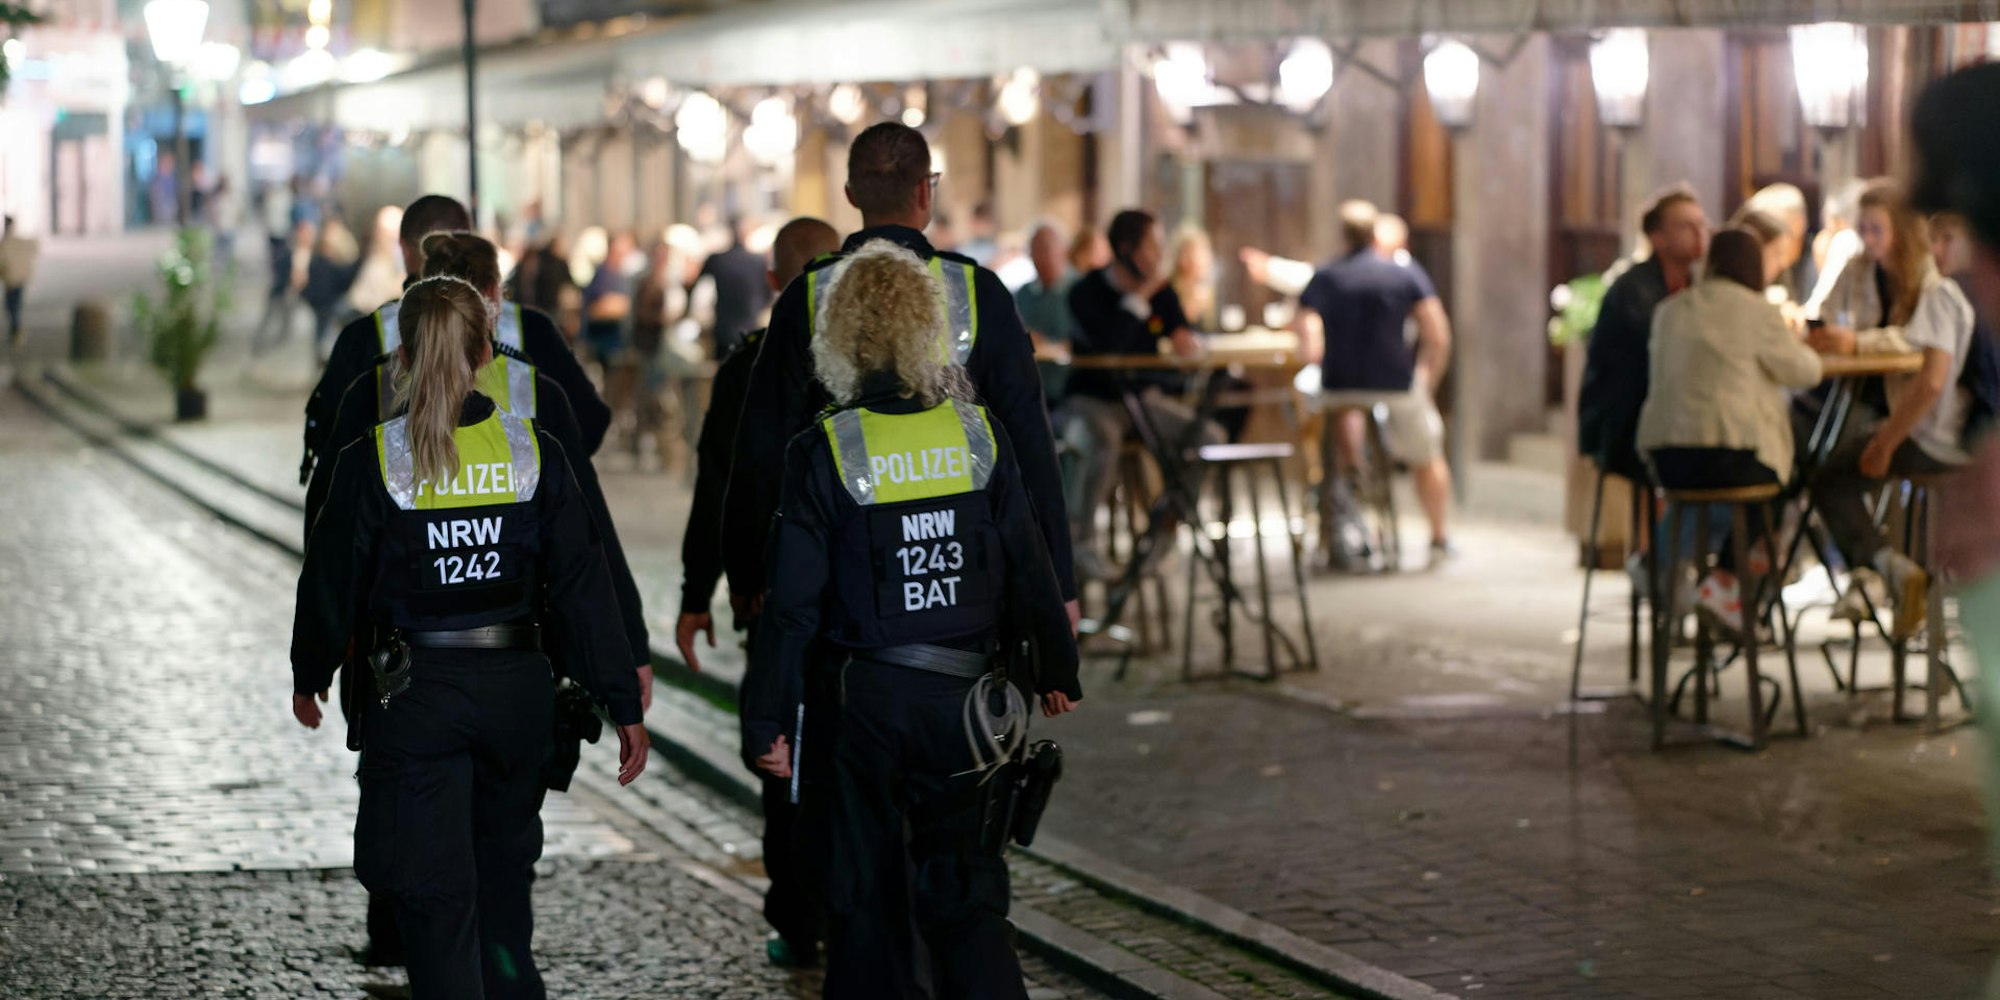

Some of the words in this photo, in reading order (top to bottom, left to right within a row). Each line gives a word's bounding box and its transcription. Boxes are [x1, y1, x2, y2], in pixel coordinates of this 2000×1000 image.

[871, 445, 969, 486] POLIZEI
[427, 516, 502, 549] NRW
[902, 509, 955, 542] NRW
[432, 551, 501, 585] 1242
[896, 541, 964, 576] 1243
[903, 576, 961, 611] BAT
